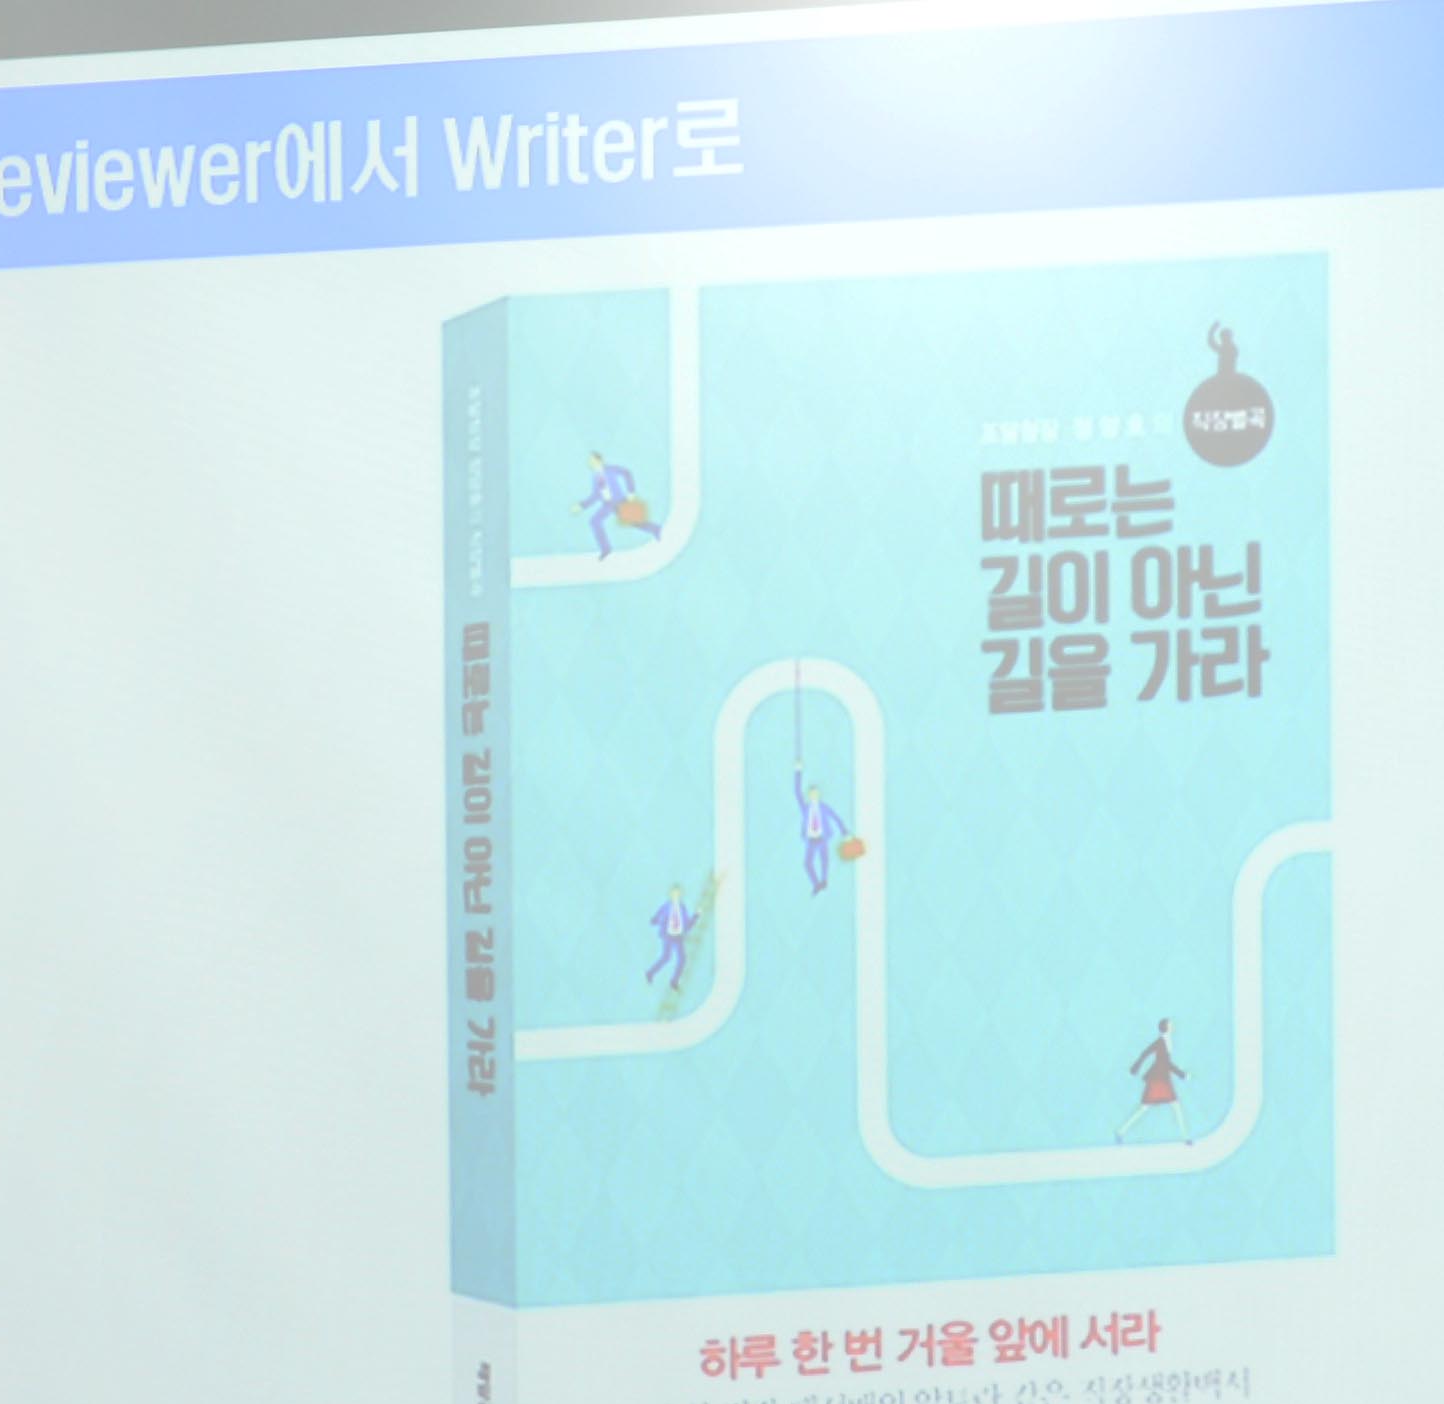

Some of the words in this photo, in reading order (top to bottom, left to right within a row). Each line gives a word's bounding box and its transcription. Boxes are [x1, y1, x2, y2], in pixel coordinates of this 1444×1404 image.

[443, 98, 745, 192] Writer로
[980, 464, 1175, 543] 때로는
[980, 549, 1110, 632] 길이
[1130, 541, 1263, 620] 아닌
[980, 632, 1112, 715] 길을
[1129, 624, 1272, 703] 가라
[698, 1333, 782, 1380] 하루
[791, 1330, 834, 1375] 한
[843, 1327, 884, 1371] 번
[896, 1320, 980, 1367] 거울
[988, 1314, 1070, 1361] 앞에
[1078, 1308, 1162, 1356] 서라
